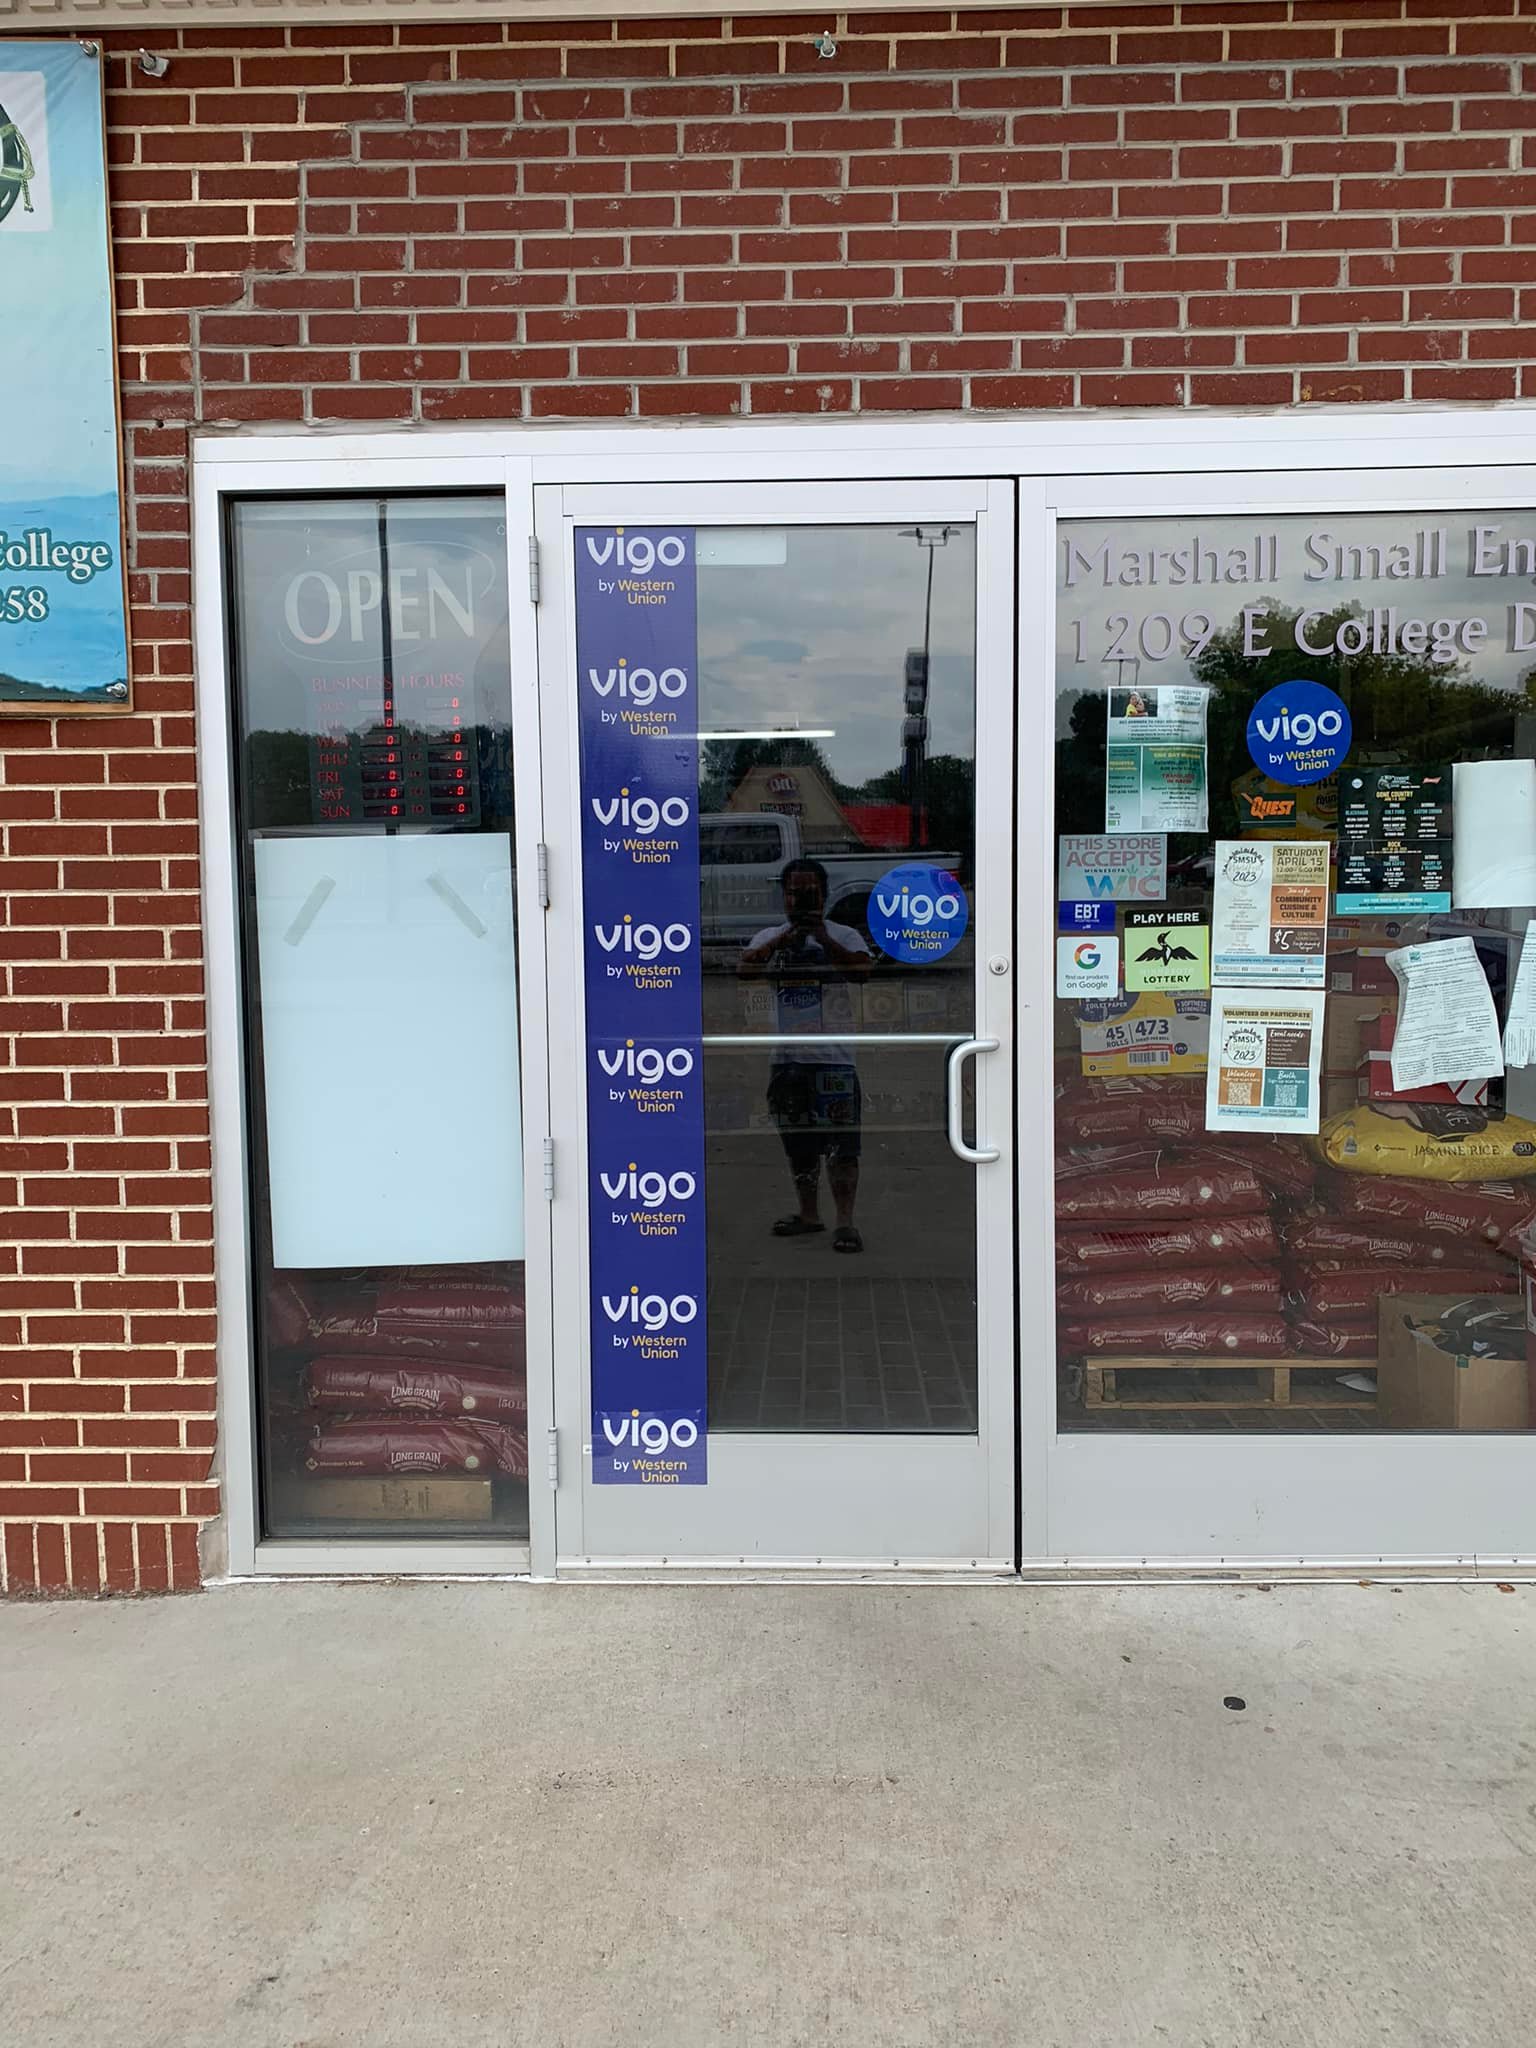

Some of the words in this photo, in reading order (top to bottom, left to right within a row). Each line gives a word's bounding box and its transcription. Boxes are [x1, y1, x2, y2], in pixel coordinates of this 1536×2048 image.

[0, 532, 109, 580] ollege
[586, 527, 686, 575] vigo
[1063, 533, 1281, 587] Marshall
[1305, 527, 1447, 580] Small
[598, 579, 615, 593] by
[618, 579, 674, 591] Western
[0, 589, 46, 620] 58
[627, 592, 666, 604] Union
[285, 567, 475, 644] OPEN
[1072, 608, 1216, 662] 1209
[1242, 606, 1272, 657] E
[1294, 605, 1488, 662] College
[312, 677, 392, 692] BUSINESS
[401, 673, 464, 689] HOURS
[589, 658, 687, 706] vigo
[601, 710, 617, 725] by
[620, 710, 677, 722] Western
[630, 723, 668, 736] Union
[1256, 707, 1342, 746] vigo
[1269, 753, 1283, 765] by
[1286, 747, 1335, 761] Western
[1295, 758, 1329, 771] Union
[320, 805, 351, 818] SUN
[591, 788, 689, 834] vigo
[604, 839, 620, 853] by
[623, 839, 679, 851] Western
[1064, 838, 1104, 850] THIS
[1107, 838, 1161, 850] STORE
[633, 852, 671, 863] Union
[1066, 851, 1162, 867] ACCEPTS
[1277, 848, 1324, 857] SATURDAY
[1277, 857, 1307, 866] APRIL
[1310, 857, 1323, 866] 15
[1232, 871, 1257, 882] 2023
[1085, 875, 1161, 898] WIC
[877, 886, 959, 925] vigo
[1075, 904, 1100, 919] EBT
[1280, 903, 1309, 911] CUISINE
[1133, 913, 1163, 924] PLAY
[1167, 912, 1200, 923] HERE
[595, 914, 691, 960] vigo
[886, 928, 899, 940] by
[902, 929, 949, 939] Western
[1274, 929, 1294, 950] $5
[910, 940, 942, 950] Union
[607, 964, 622, 979] by
[625, 965, 681, 976] Western
[635, 977, 672, 989] Union
[1079, 981, 1108, 991] Google
[1143, 975, 1191, 984] LOTTERY
[1270, 1011, 1310, 1019] PARTICIPATE
[1106, 1026, 1125, 1040] 45
[1135, 1019, 1169, 1036] 473
[1106, 1040, 1129, 1048] ROLLS
[598, 1039, 693, 1084] vigo
[1233, 1050, 1256, 1061] 2023
[1226, 1068, 1256, 1078] Volunteer
[609, 1089, 625, 1102] by
[628, 1089, 683, 1100] Western
[637, 1101, 675, 1113] Union
[1148, 1117, 1166, 1127] LONG
[1167, 1118, 1190, 1129] GRAIN
[1415, 1145, 1465, 1157] JASMINE
[1470, 1144, 1501, 1155] RICE
[600, 1162, 696, 1208] vigo
[1137, 1188, 1156, 1200] LONG
[1157, 1186, 1180, 1197] GRAIN
[612, 1212, 627, 1226] by
[631, 1212, 685, 1223] Western
[1425, 1210, 1445, 1222] LONG
[1445, 1214, 1469, 1227] GRAIN
[640, 1224, 678, 1236] Union
[1149, 1236, 1166, 1249] LONG
[1166, 1234, 1191, 1244] GRAIN
[1368, 1240, 1387, 1251] LONG
[602, 1286, 697, 1331] vigo
[613, 1335, 628, 1349] by
[632, 1335, 687, 1347] Western
[641, 1347, 679, 1359] Union
[391, 1386, 413, 1399] LONG
[414, 1387, 441, 1402] GRAIN
[603, 1409, 698, 1455] vigo
[391, 1452, 414, 1465] LONG
[414, 1452, 441, 1465] GRAIN
[613, 1459, 629, 1472] by
[632, 1459, 687, 1470] Western
[641, 1472, 679, 1483] Union
